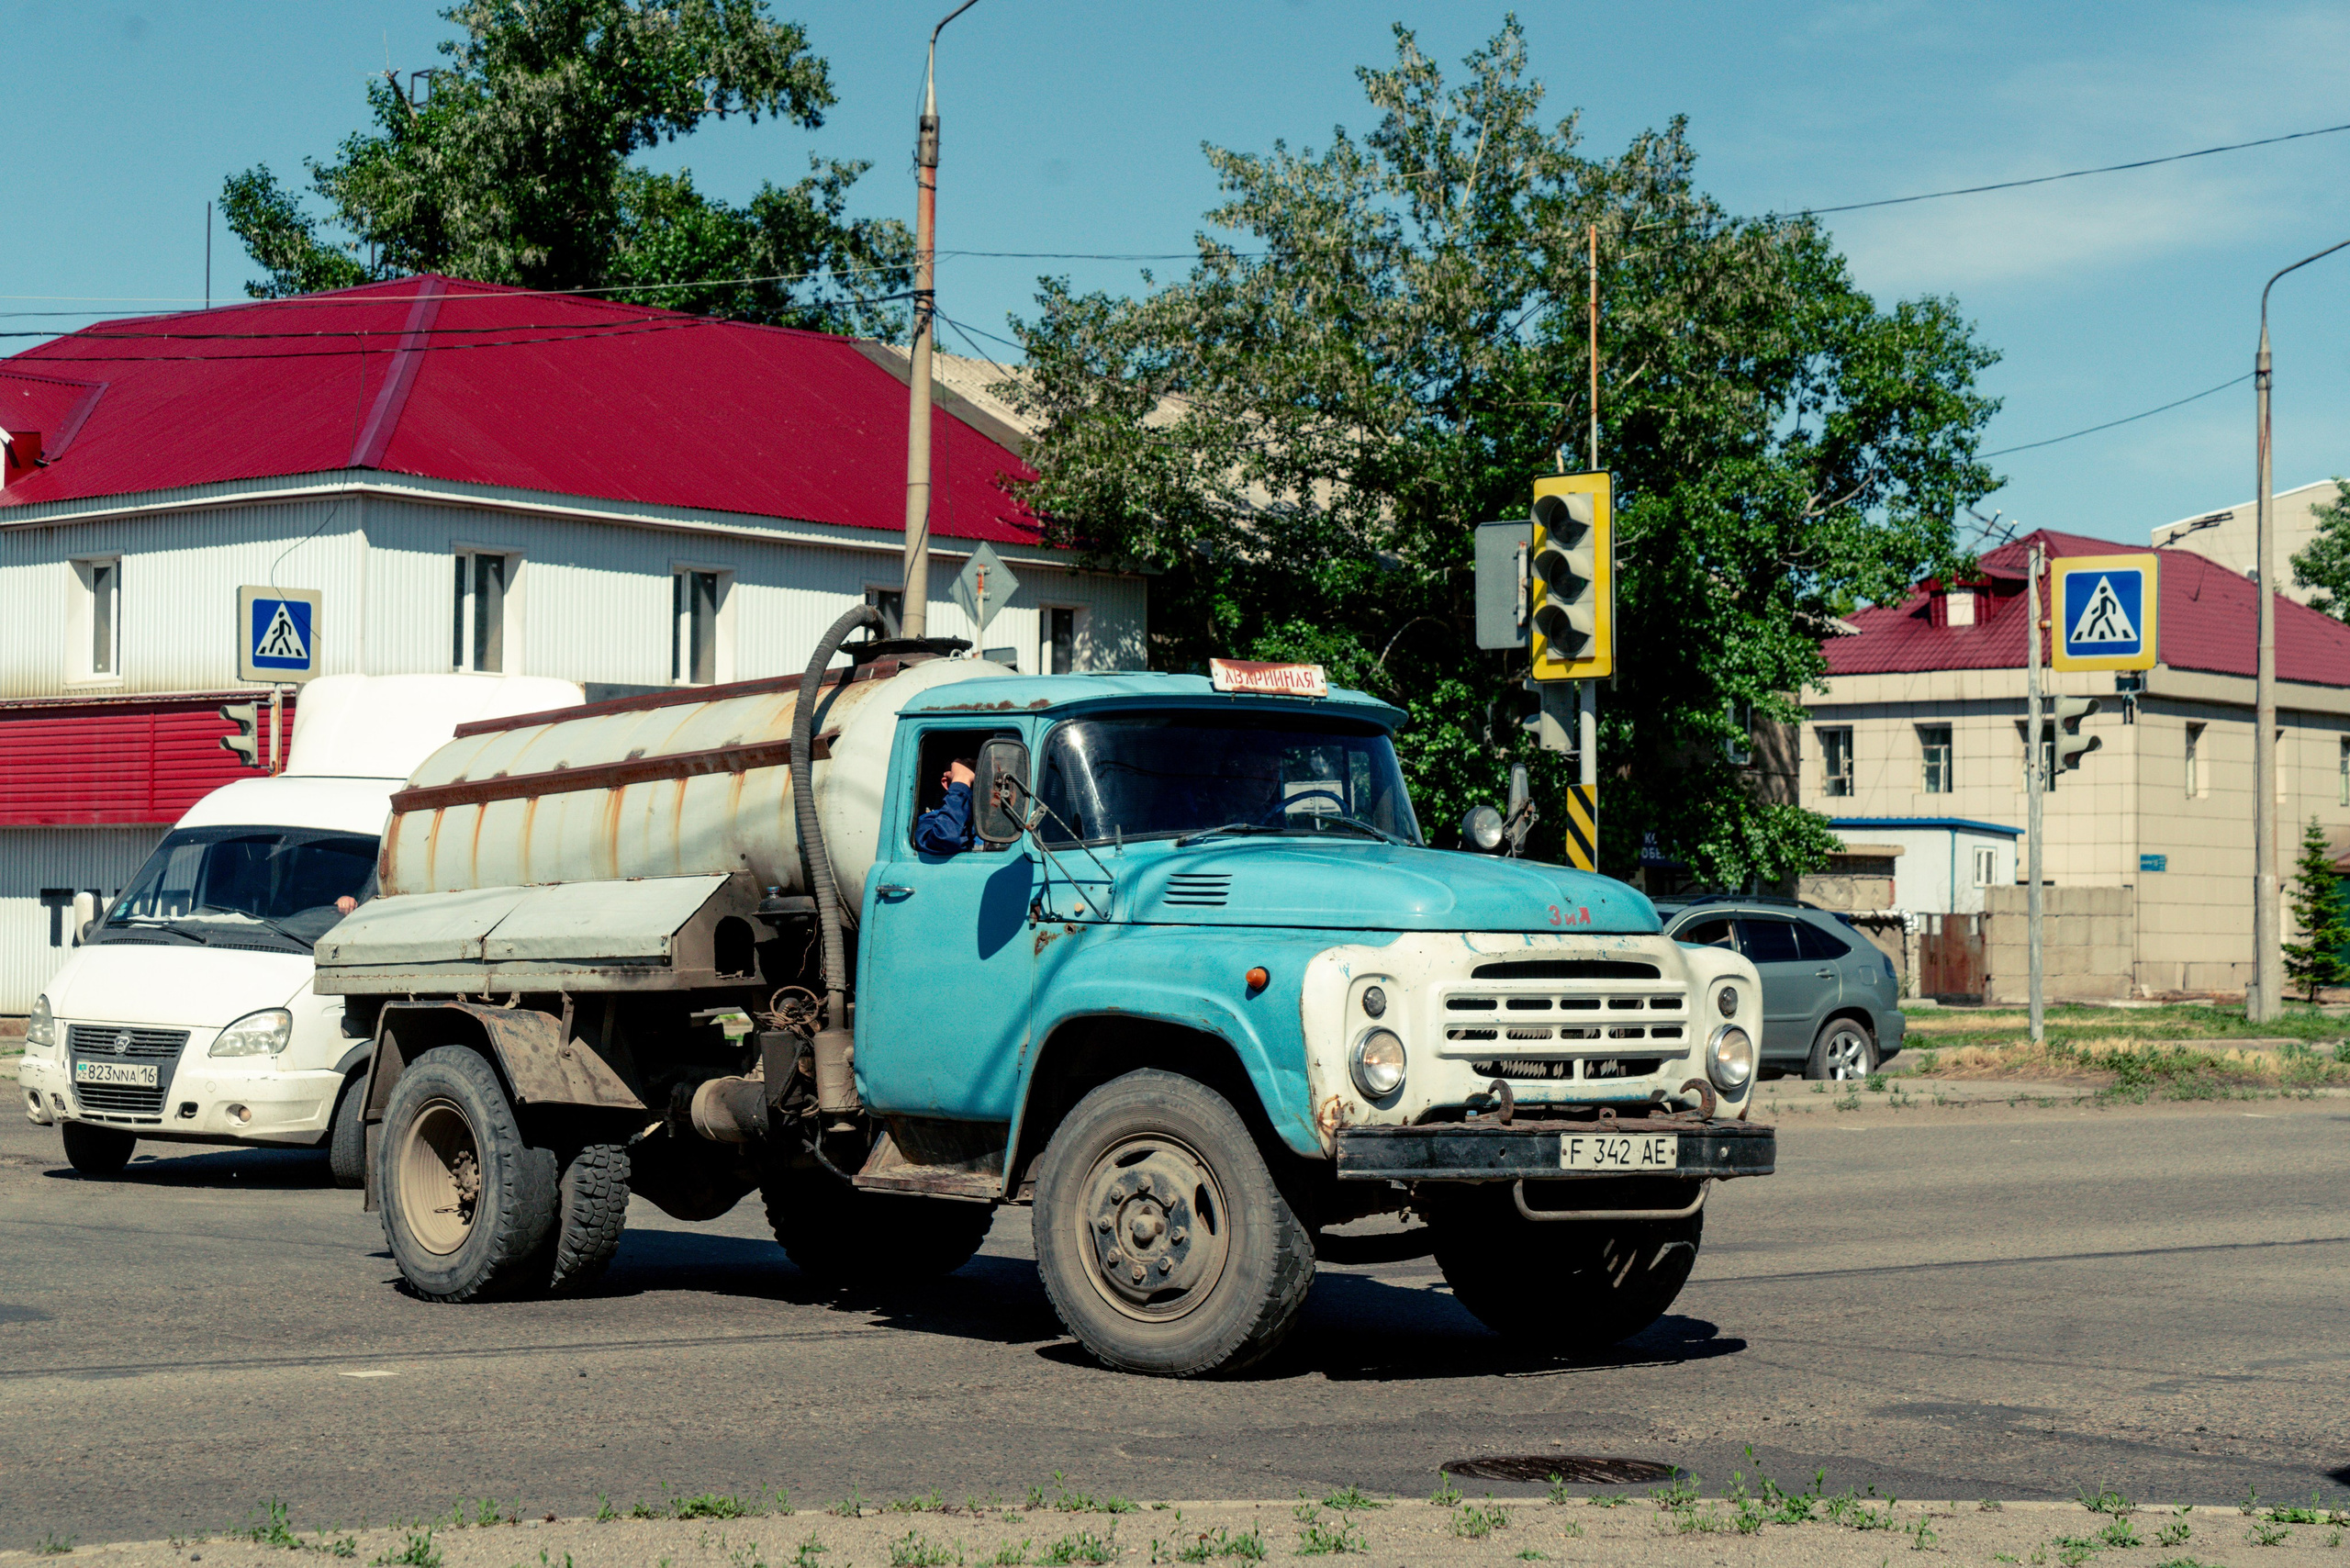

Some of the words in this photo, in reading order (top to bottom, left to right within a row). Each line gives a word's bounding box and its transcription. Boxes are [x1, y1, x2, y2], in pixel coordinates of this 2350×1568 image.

[140, 1068, 155, 1083] 16
[1571, 1138, 1583, 1165] F
[1594, 1138, 1630, 1165] 342
[1641, 1138, 1667, 1165] AE
